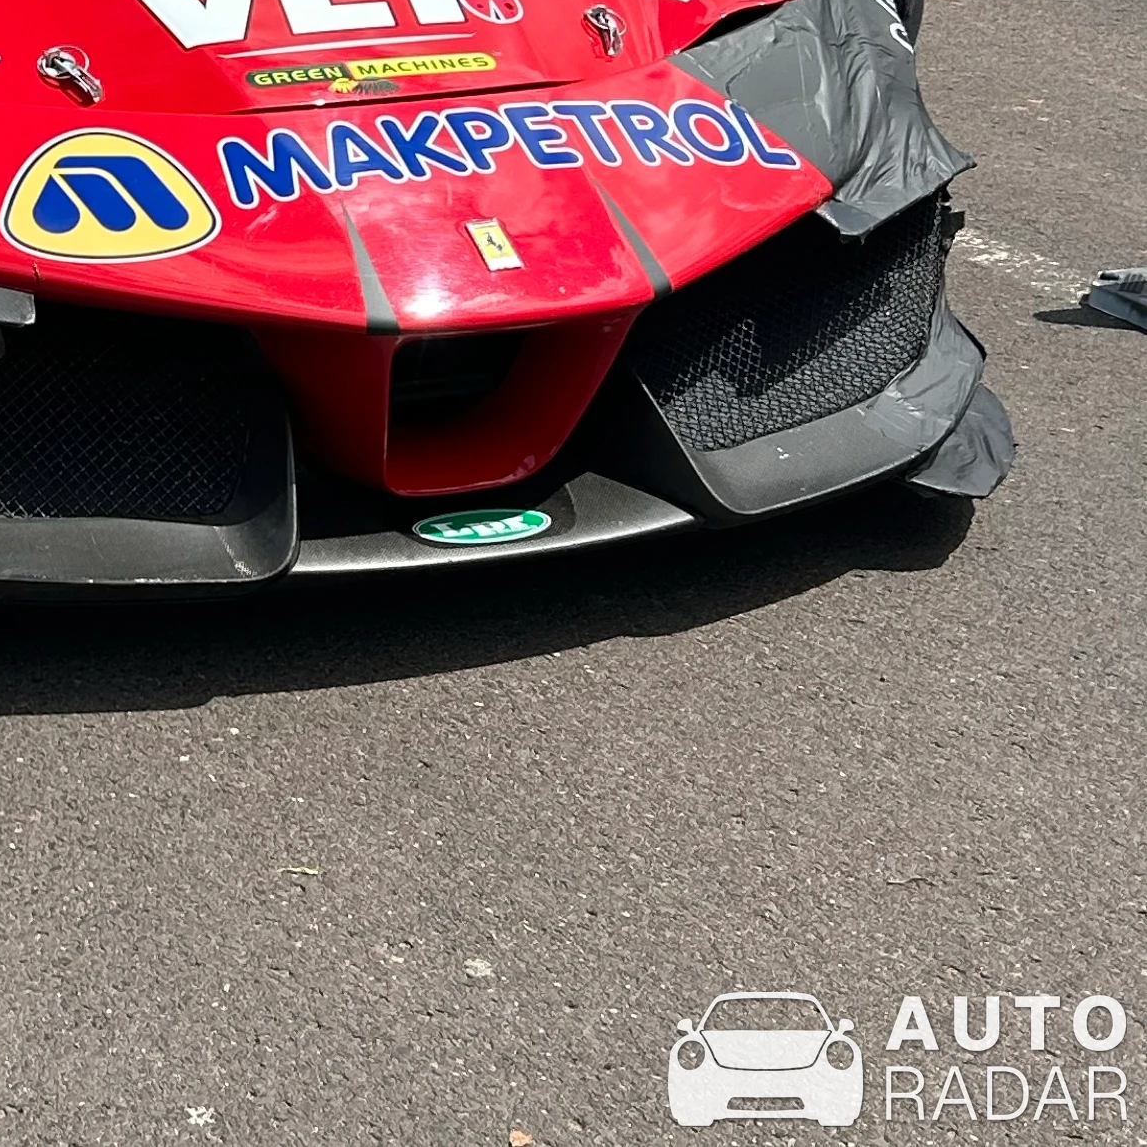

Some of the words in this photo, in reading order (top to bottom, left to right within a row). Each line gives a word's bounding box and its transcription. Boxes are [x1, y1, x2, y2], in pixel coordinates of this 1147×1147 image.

[253, 66, 343, 86] GREEN
[356, 56, 490, 76] MACHINES
[217, 99, 801, 209] MAKPETROL
